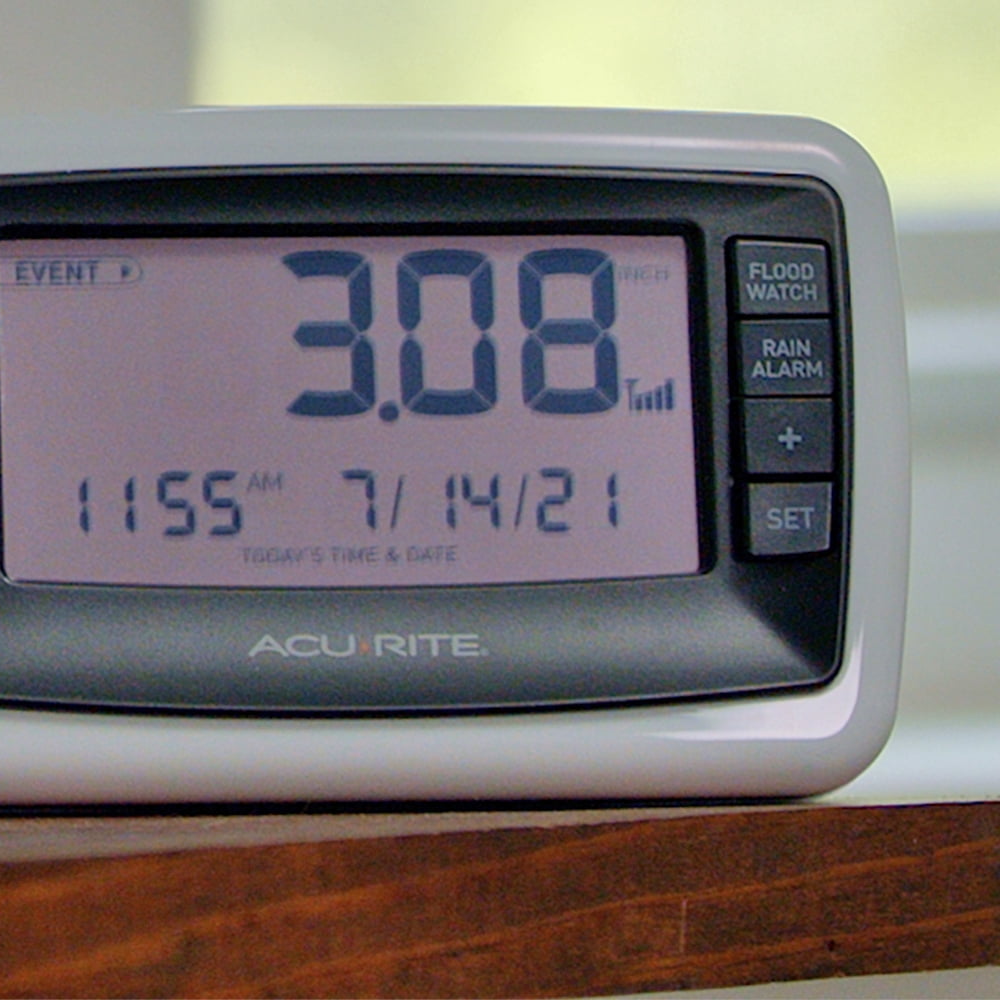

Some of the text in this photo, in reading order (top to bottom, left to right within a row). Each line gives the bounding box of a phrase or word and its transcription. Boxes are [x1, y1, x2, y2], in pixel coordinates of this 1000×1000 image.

[15, 260, 99, 285] EVENT
[749, 262, 814, 281] FLOOD
[746, 282, 817, 301] WATCH
[282, 247, 619, 421] 3.08
[762, 338, 811, 357] RAIN
[752, 359, 823, 378] ALARM
[247, 472, 282, 493] AM
[766, 507, 815, 531] SET
[242, 545, 457, 564] TODAY'S TIME & DATE
